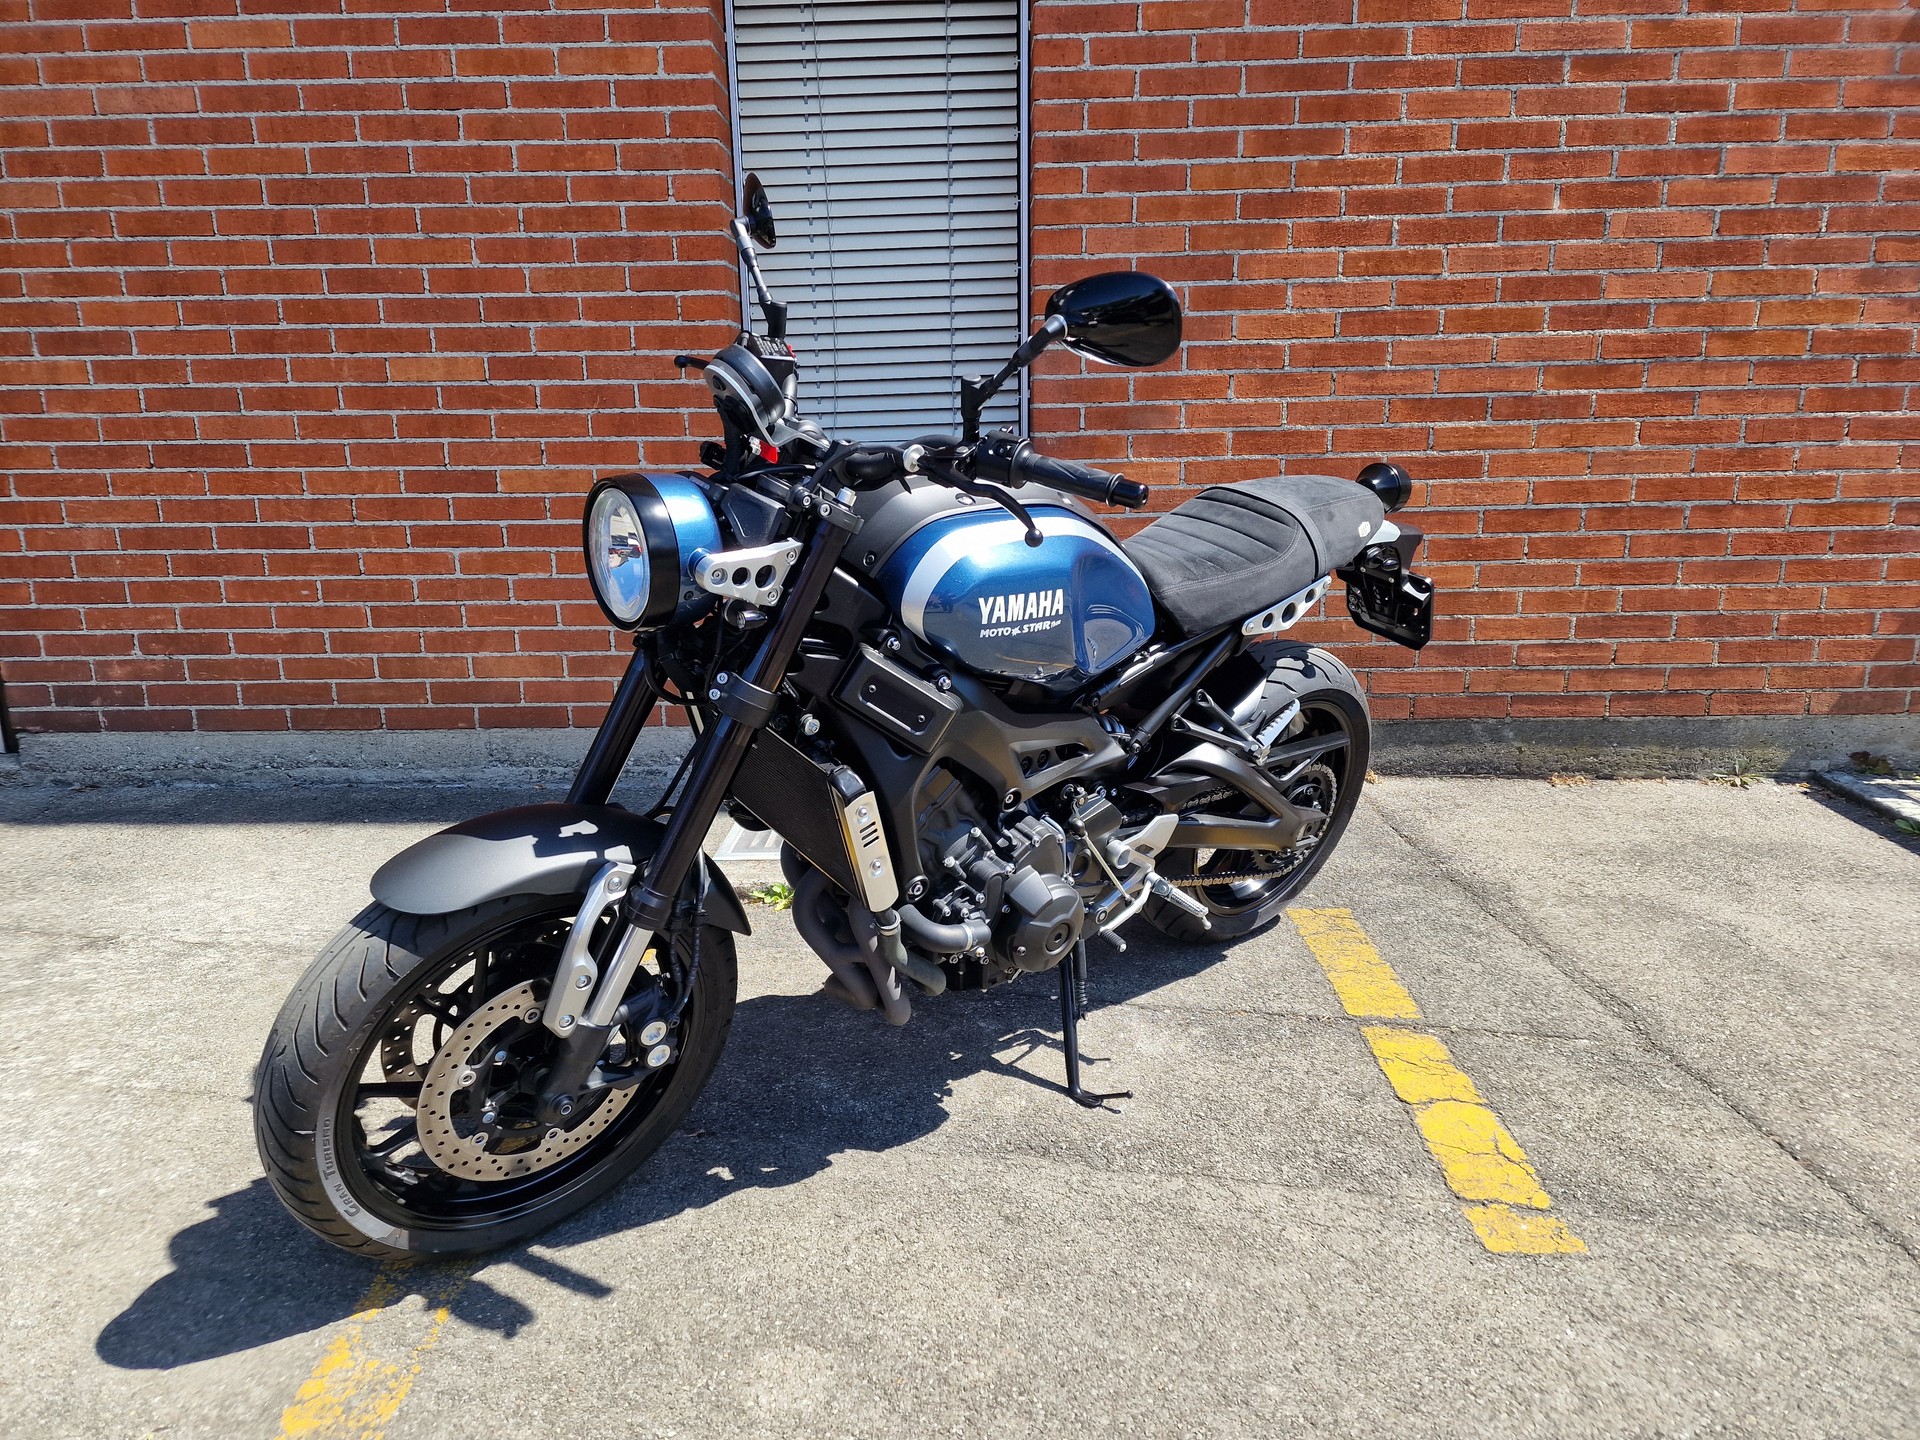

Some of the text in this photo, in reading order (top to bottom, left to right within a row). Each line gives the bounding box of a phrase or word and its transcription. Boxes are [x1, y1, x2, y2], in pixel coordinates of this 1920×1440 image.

[978, 588, 1064, 625] YAMAHA
[979, 626, 1011, 638] MOTO
[1022, 620, 1051, 634] STAR
